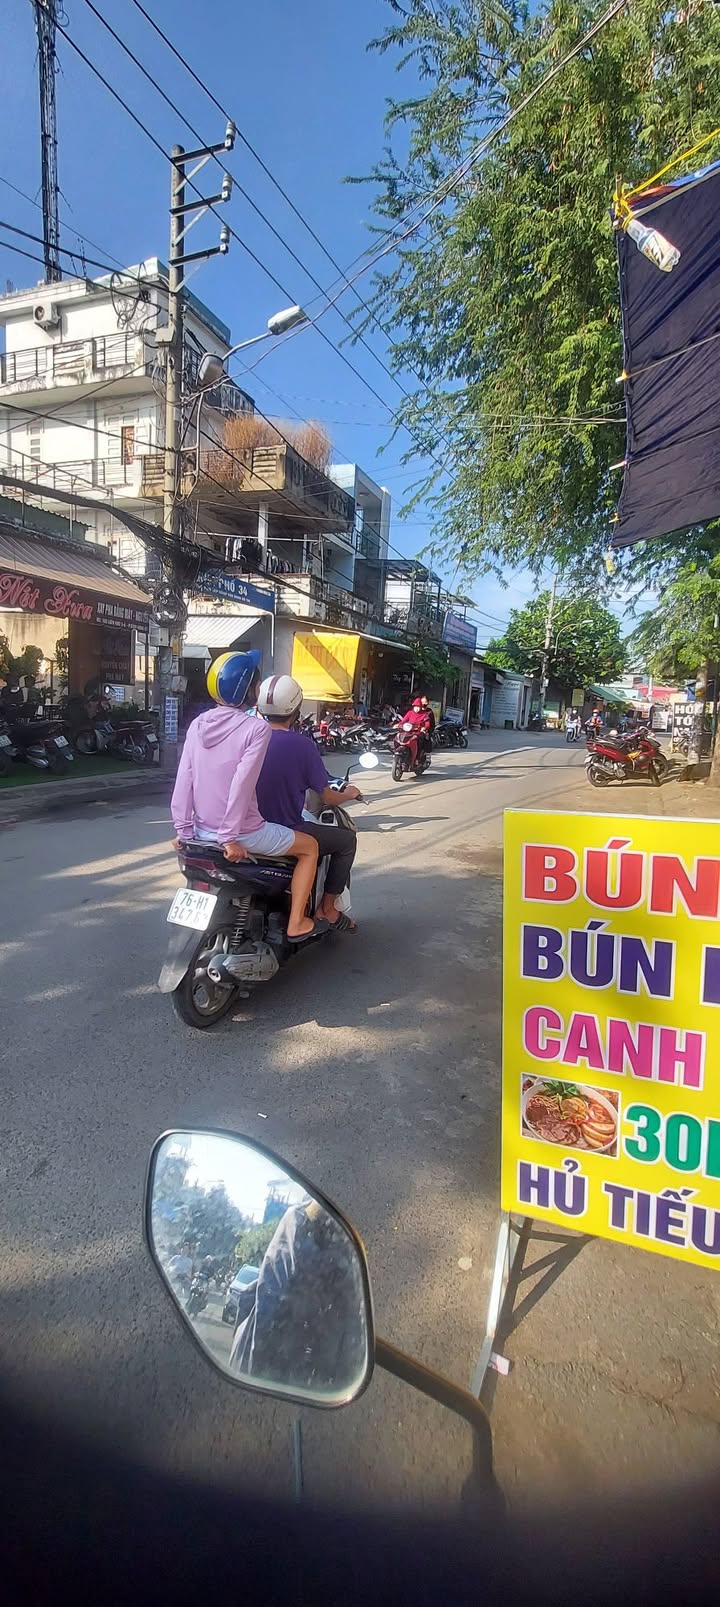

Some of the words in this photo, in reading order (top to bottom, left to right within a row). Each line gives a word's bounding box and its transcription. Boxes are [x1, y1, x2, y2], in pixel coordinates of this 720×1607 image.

[238, 585, 248, 597] 34
[180, 892, 208, 911] 76-H1
[522, 840, 720, 920] BÚN
[521, 921, 675, 998] BÚN
[523, 1006, 705, 1089] CANH
[519, 1159, 587, 1218] HỦ
[603, 1187, 720, 1257] TIẾU
